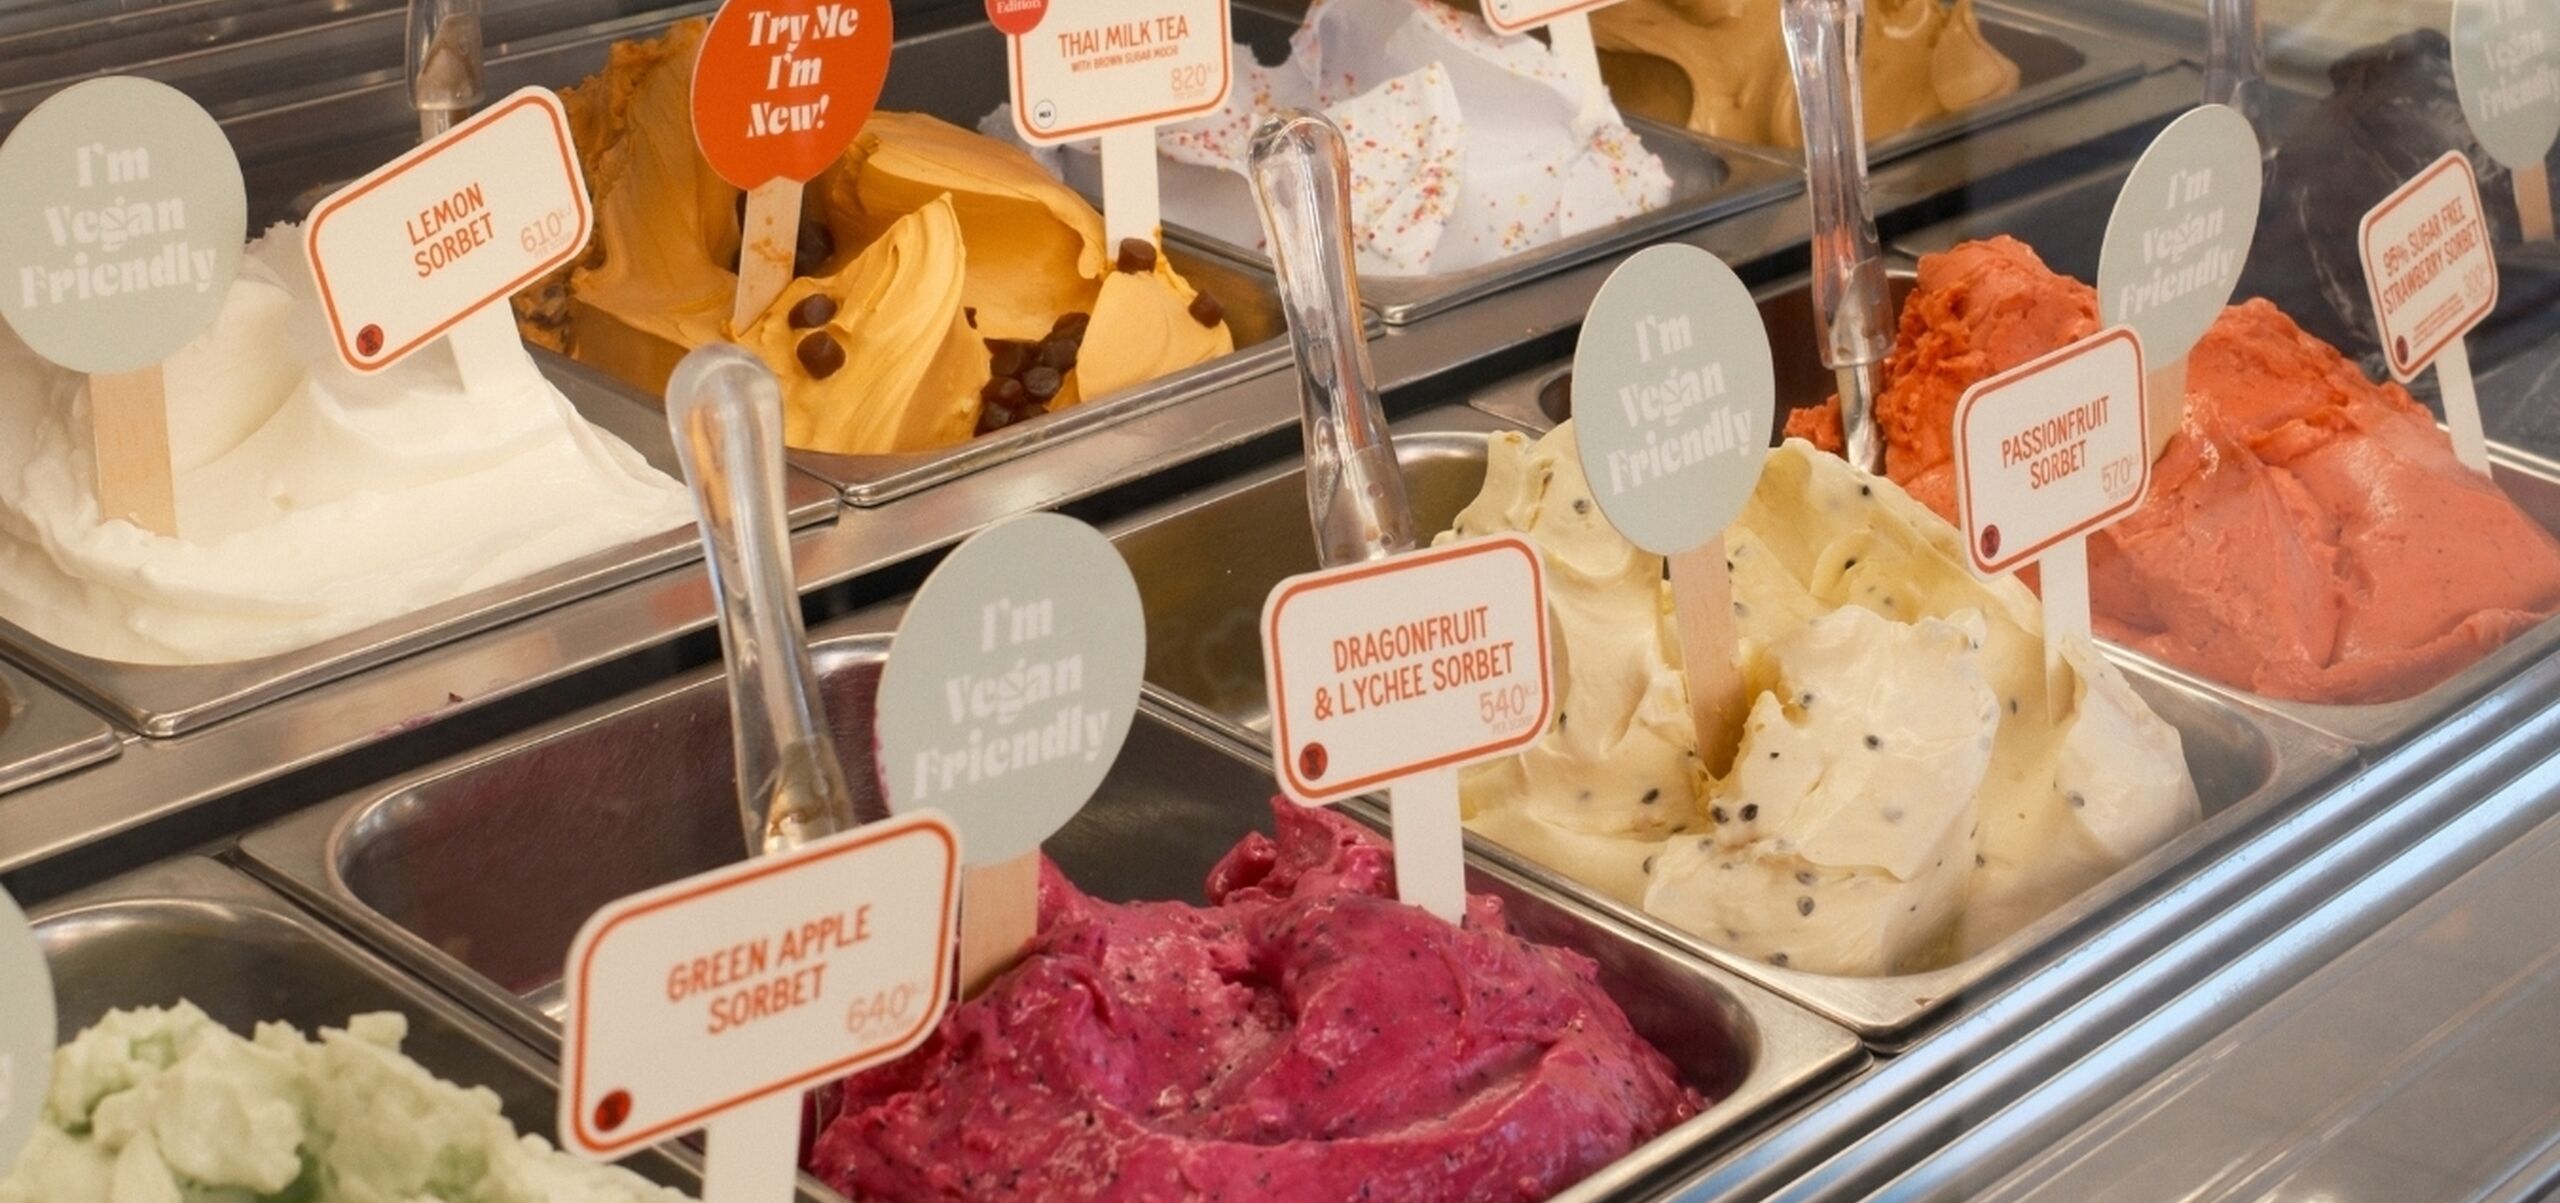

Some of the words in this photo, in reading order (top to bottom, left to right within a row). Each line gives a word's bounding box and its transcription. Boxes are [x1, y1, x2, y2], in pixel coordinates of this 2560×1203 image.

[748, 11, 809, 52] Try
[812, 4, 859, 39] Me
[1058, 29, 1099, 58] THAI
[1105, 20, 1152, 50] MILK
[1156, 15, 1189, 42] TEA
[767, 53, 822, 90] I'm
[1071, 60, 1092, 72] WITH
[1094, 54, 1123, 69] BROWN
[746, 94, 830, 138] New!
[77, 142, 150, 188] I'm
[2168, 167, 2212, 210] I'm
[45, 196, 186, 253] Vegan
[406, 182, 485, 246] LEMON
[414, 212, 494, 278] SORBET
[2143, 208, 2224, 264] Vegan
[19, 240, 217, 308] Friendly
[2118, 244, 2236, 321] Friendly
[2383, 247, 2444, 315] STRAWBERRY
[2444, 219, 2481, 265] SORBET
[1635, 314, 1693, 364] I'm
[1618, 361, 1727, 427] Vegan
[1607, 405, 1754, 495] Friendly
[2002, 395, 2109, 469] PASSIONFRUIT
[2030, 439, 2087, 489] SORBET
[980, 598, 1053, 651] I'm
[1333, 606, 1488, 673] DRAGONFRUIT
[946, 653, 1083, 725] Vegan
[1314, 687, 1333, 721] &
[1339, 663, 1427, 715] LYCHEE
[1431, 641, 1514, 692] SORBET
[913, 703, 1110, 800] Friendly
[666, 937, 768, 1002] GREEN
[777, 903, 872, 967] APPLE
[708, 962, 827, 1034] SORBET
